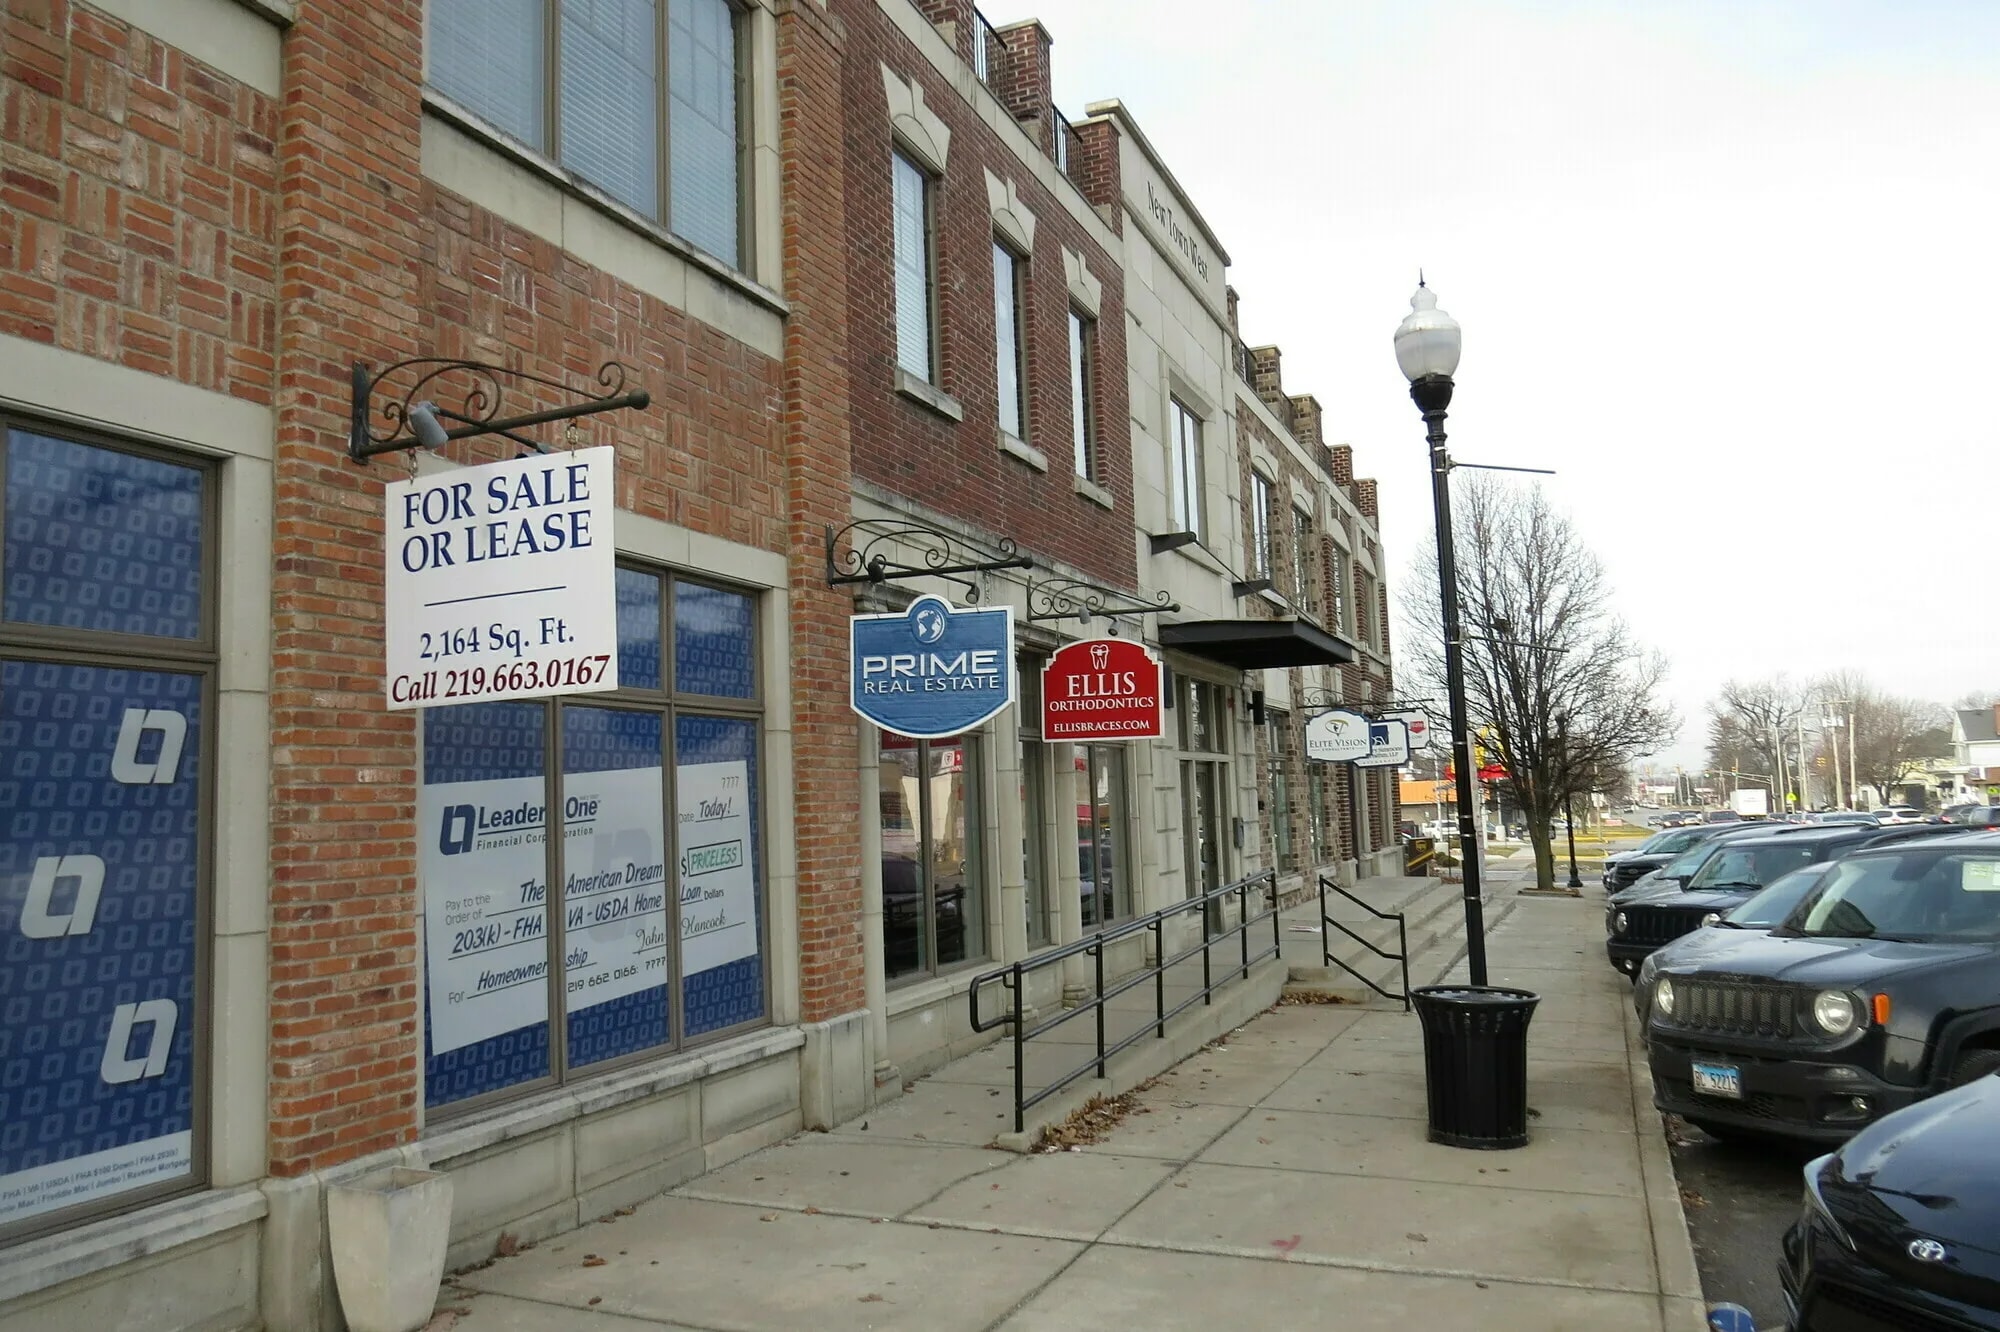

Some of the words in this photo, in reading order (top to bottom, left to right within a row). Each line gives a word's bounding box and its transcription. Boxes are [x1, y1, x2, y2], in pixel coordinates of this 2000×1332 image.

[1148, 181, 1165, 227] New
[1167, 208, 1189, 257] Town
[1189, 236, 1208, 283] West
[403, 482, 475, 529] FOR
[488, 464, 590, 514] SALE
[402, 531, 455, 572] OR
[465, 510, 592, 563] LEASE
[420, 627, 480, 662] 2,164
[489, 623, 529, 658] Sq.
[539, 617, 574, 645] Ft.
[863, 650, 998, 679] PRIME
[392, 671, 438, 703] Call
[445, 655, 610, 698] 219.663.0167
[864, 678, 915, 695] REAL
[925, 676, 999, 692] ESTATE
[1066, 672, 1136, 697] ELLIS
[1050, 697, 1154, 712] ORTHODONTICS
[1054, 720, 1150, 733] ELLISBRACES.COM
[1309, 739, 1333, 748] ELITE
[1335, 738, 1367, 747] VISION
[478, 802, 546, 829] Leader
[565, 796, 598, 819] One
[679, 812, 695, 824] Date
[700, 796, 732, 821] Today!
[477, 835, 522, 850] Financial
[691, 847, 737, 872] PRICELESS
[520, 878, 546, 904] The
[565, 869, 622, 896] American
[626, 862, 663, 884] Dream
[681, 885, 702, 902] Loan
[704, 888, 724, 900] Dollars
[445, 900, 461, 911] Pay
[463, 897, 473, 907] to
[475, 894, 491, 905] the
[445, 914, 471, 926] Order
[472, 909, 483, 919] of
[452, 923, 501, 954] 203(k)
[513, 914, 543, 940] FHA
[568, 907, 583, 928] VA
[595, 899, 629, 922] USDA
[634, 894, 662, 912] Home
[635, 927, 665, 953] John
[681, 908, 726, 935] Hancock
[567, 981, 584, 993] 219
[588, 973, 610, 987] 662
[448, 991, 465, 1004] For
